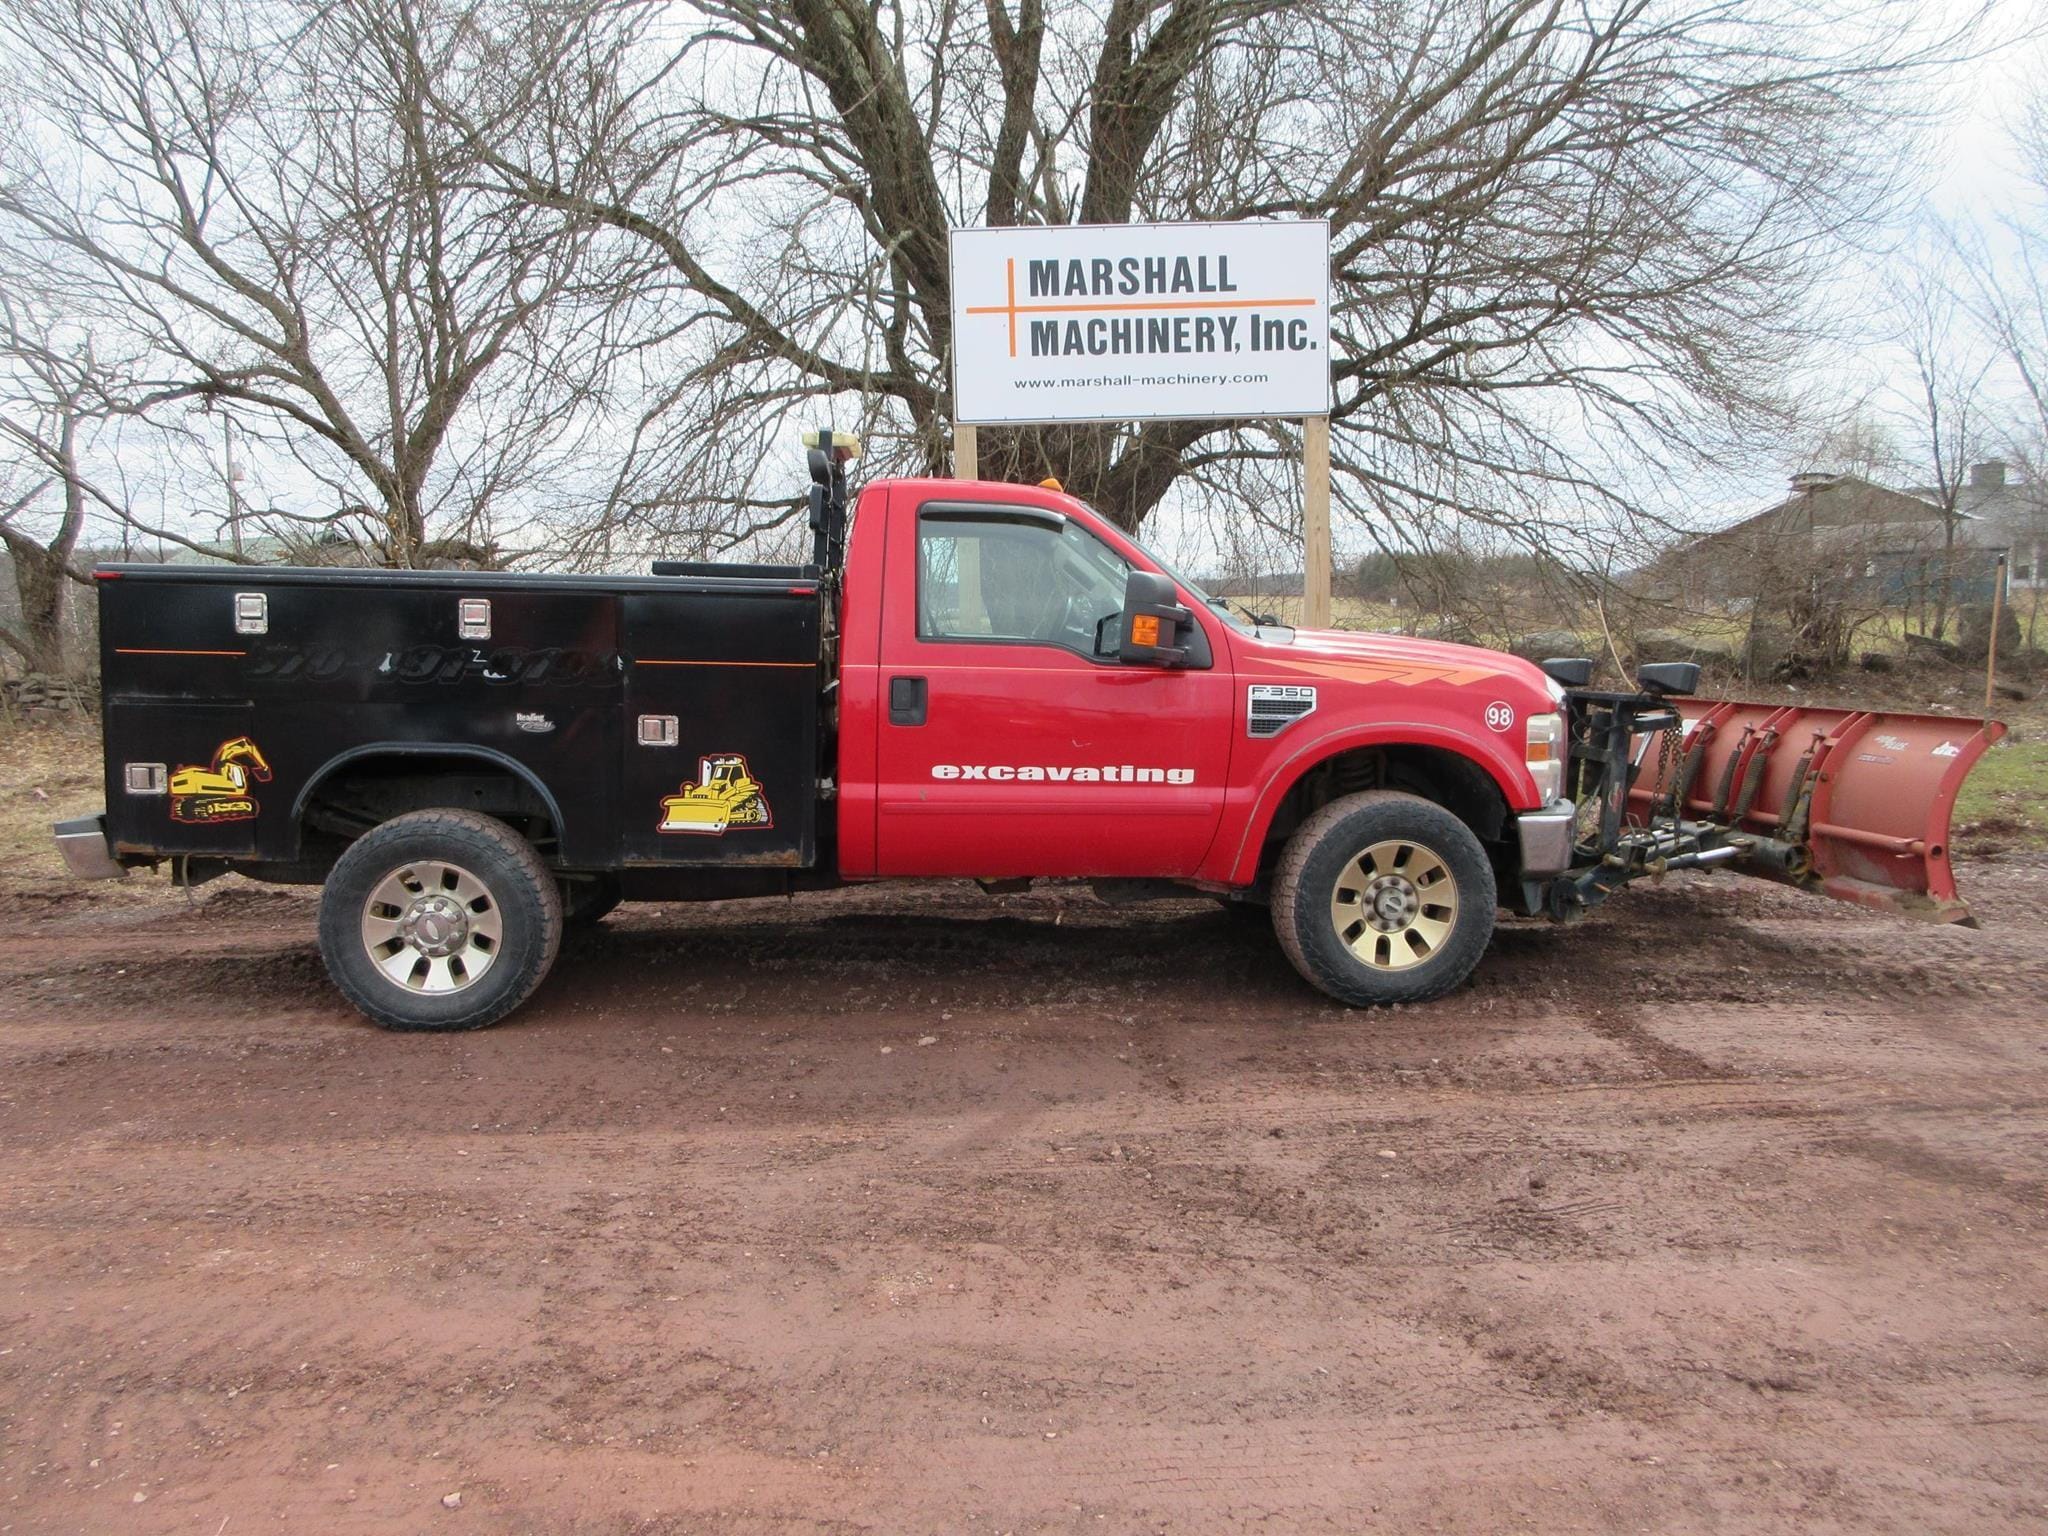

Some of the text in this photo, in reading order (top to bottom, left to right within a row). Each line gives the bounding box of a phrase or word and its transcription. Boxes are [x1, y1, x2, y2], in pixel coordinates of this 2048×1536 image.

[1029, 255, 1238, 297] MARSHALL
[1030, 313, 1318, 357] MACHINERY, Inc.
[1014, 372, 1269, 390] www.marshall-machinery.com
[1488, 707, 1511, 726] 98
[931, 765, 1195, 785] excavating
